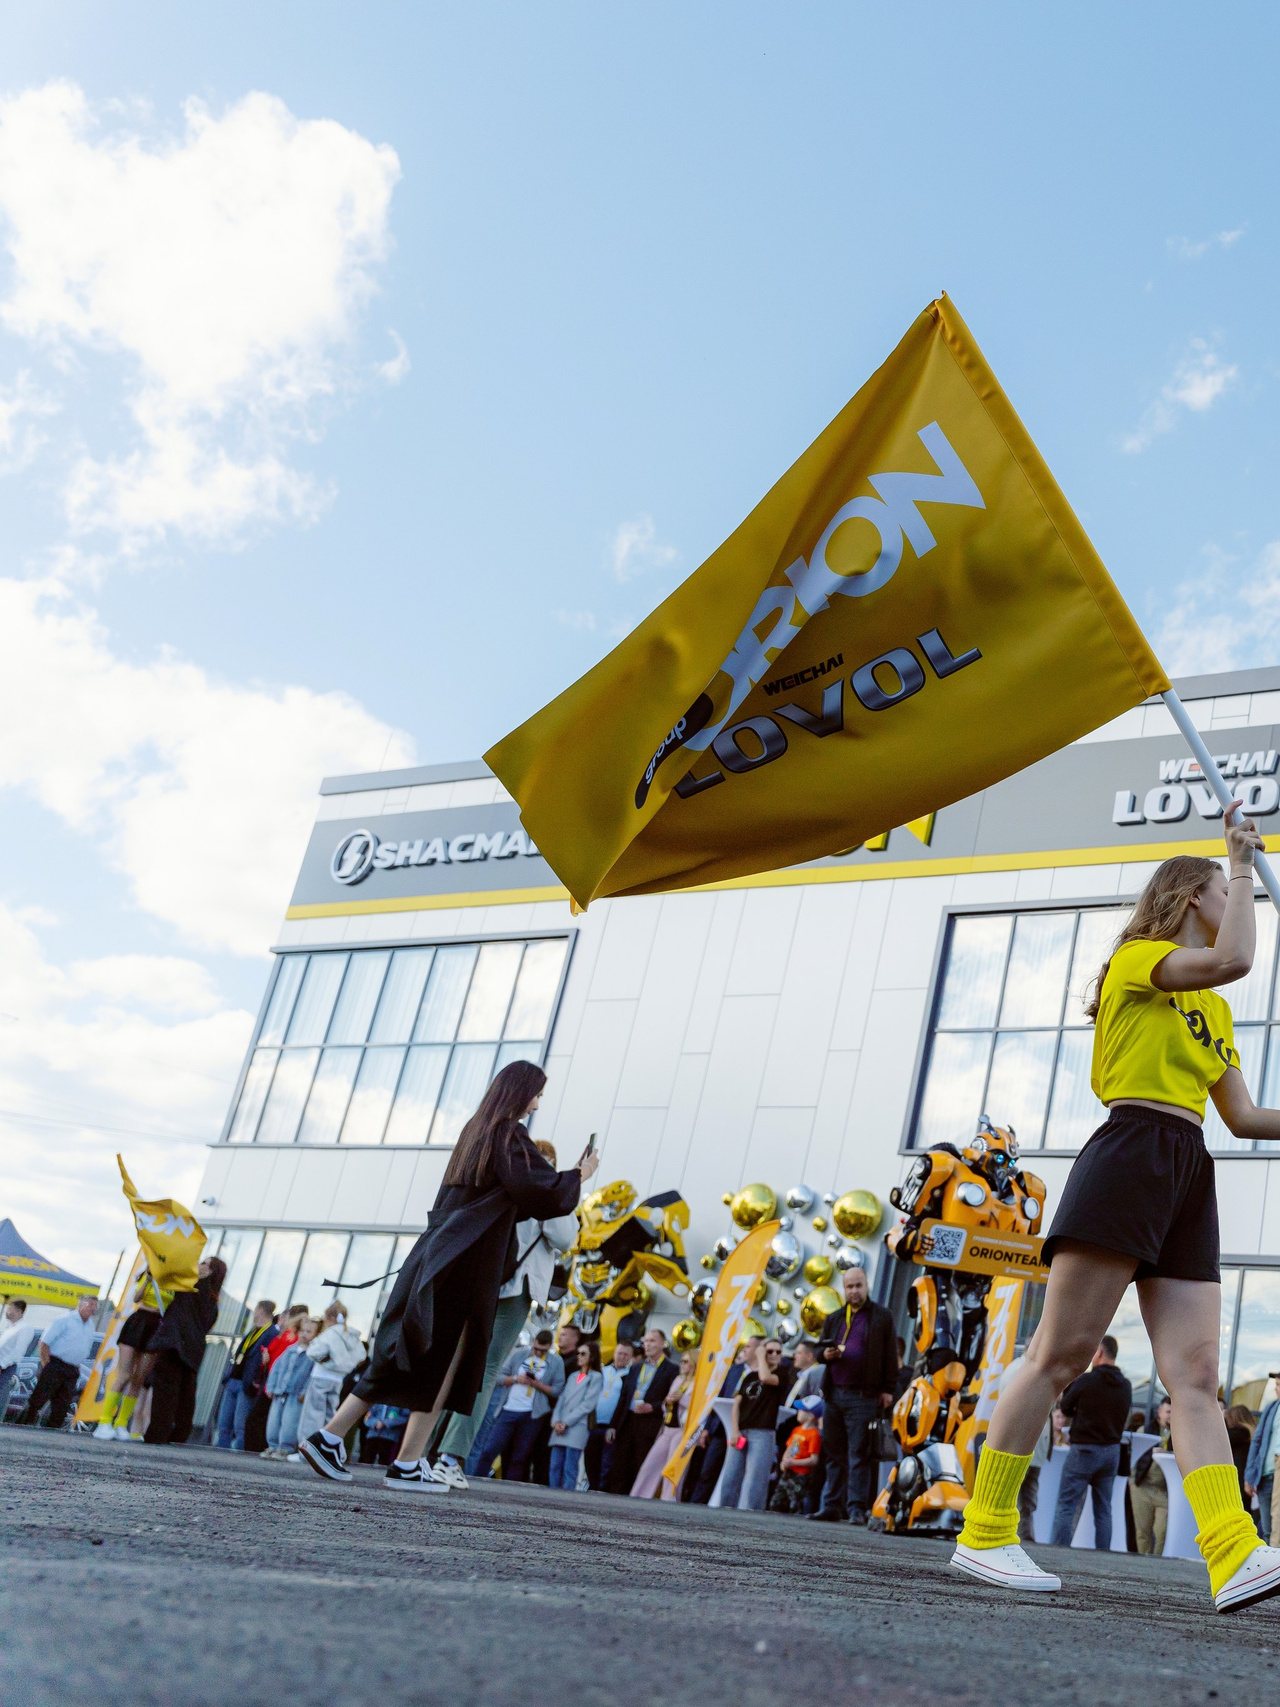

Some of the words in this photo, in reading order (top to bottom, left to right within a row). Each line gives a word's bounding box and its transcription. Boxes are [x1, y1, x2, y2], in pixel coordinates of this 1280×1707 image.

[762, 652, 845, 697] WEICHAI
[645, 716, 687, 785] group
[1159, 750, 1280, 782] WECHAI
